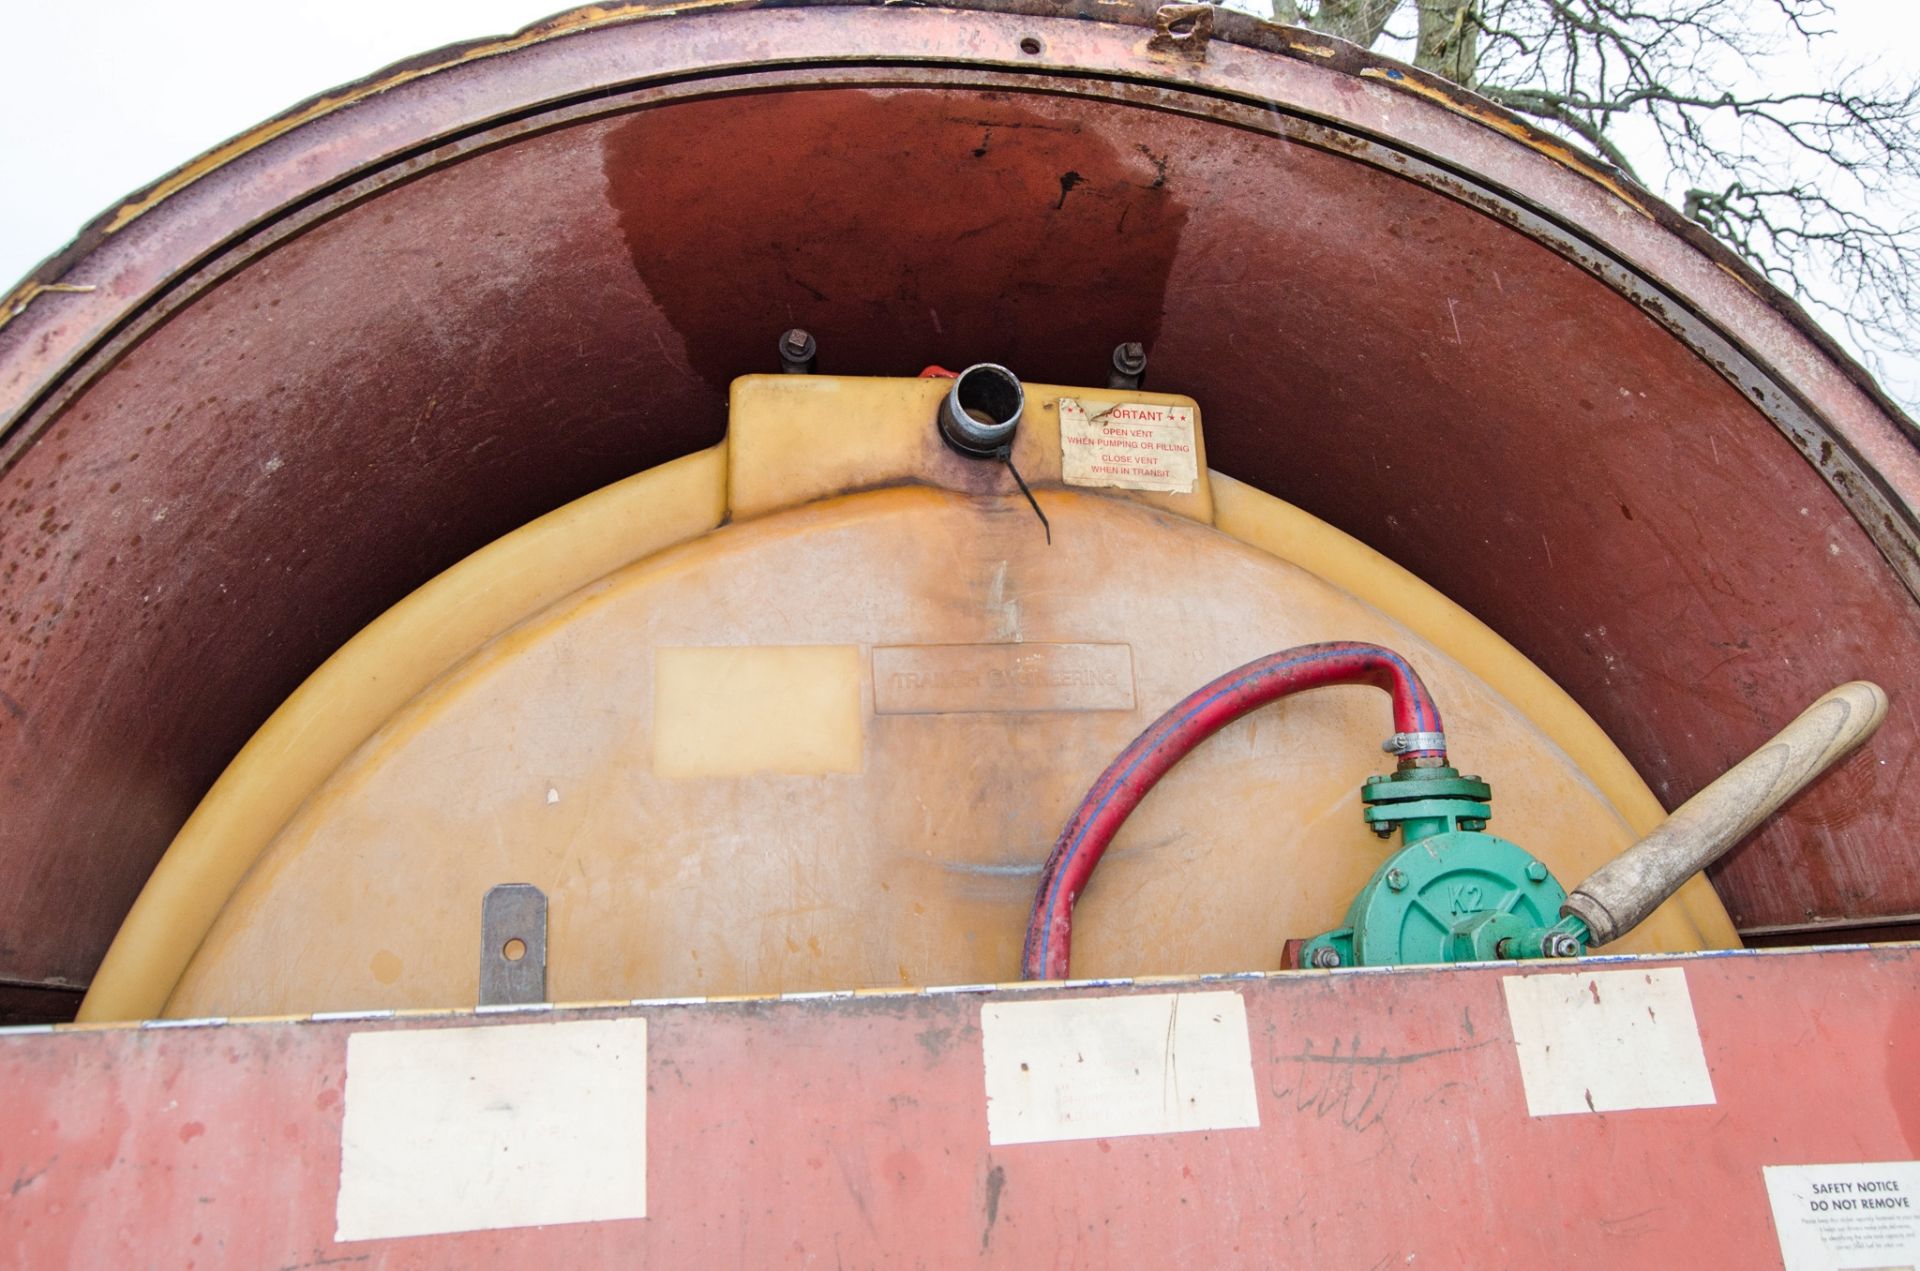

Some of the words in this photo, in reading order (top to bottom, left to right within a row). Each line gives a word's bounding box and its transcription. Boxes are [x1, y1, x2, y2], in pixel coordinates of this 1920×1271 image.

[1105, 408, 1164, 421] PORTANT
[1103, 428, 1128, 436] OPEN
[1130, 430, 1153, 438] VENT
[1067, 437, 1094, 446] WHEN
[1097, 439, 1138, 449] PUMPING
[1140, 441, 1154, 450] OR
[1156, 443, 1190, 453] FILLING
[1101, 454, 1132, 463] CLOSE
[1134, 456, 1158, 465] VENT
[1091, 465, 1118, 474] WHEN
[1121, 467, 1130, 475] IN
[1133, 468, 1170, 477] TRANSIT
[1447, 884, 1484, 914] K2
[1812, 1183, 1852, 1194] SAFETY
[1857, 1181, 1900, 1193] NOTICE
[1810, 1200, 1828, 1211] DO
[1832, 1199, 1857, 1210] NOT
[1862, 1197, 1910, 1209] REMOVE
